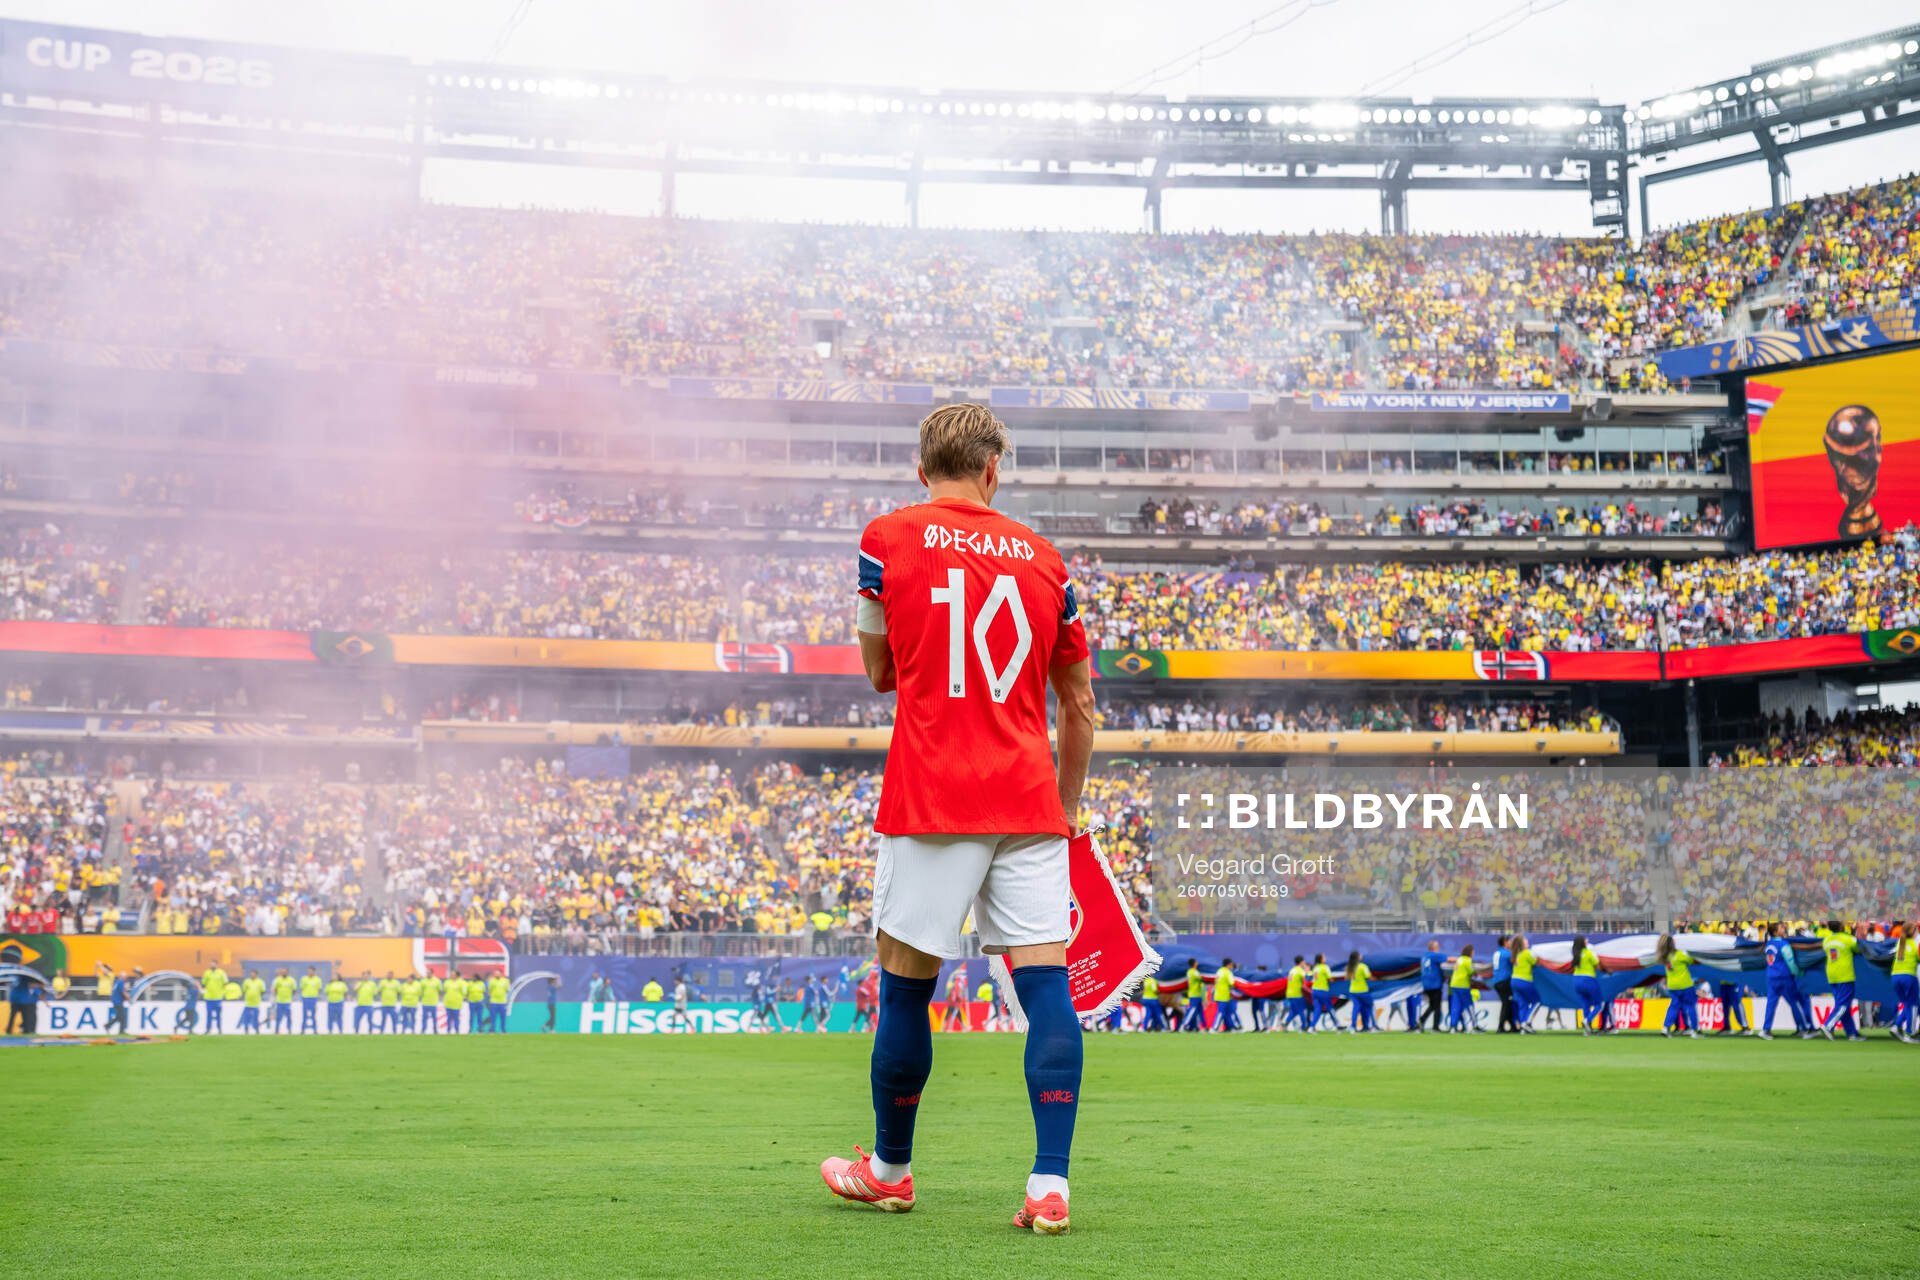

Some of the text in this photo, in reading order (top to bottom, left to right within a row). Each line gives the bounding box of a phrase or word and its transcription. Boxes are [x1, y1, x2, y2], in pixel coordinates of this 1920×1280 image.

[26, 37, 274, 88] CUP 2026
[1322, 393, 1558, 408] NEW YORK NEW JERSEY
[924, 524, 1035, 561] ØDEGAARD
[930, 568, 1033, 704] 10
[1089, 950, 1102, 960] 2026
[579, 1002, 771, 1034] Hisense
